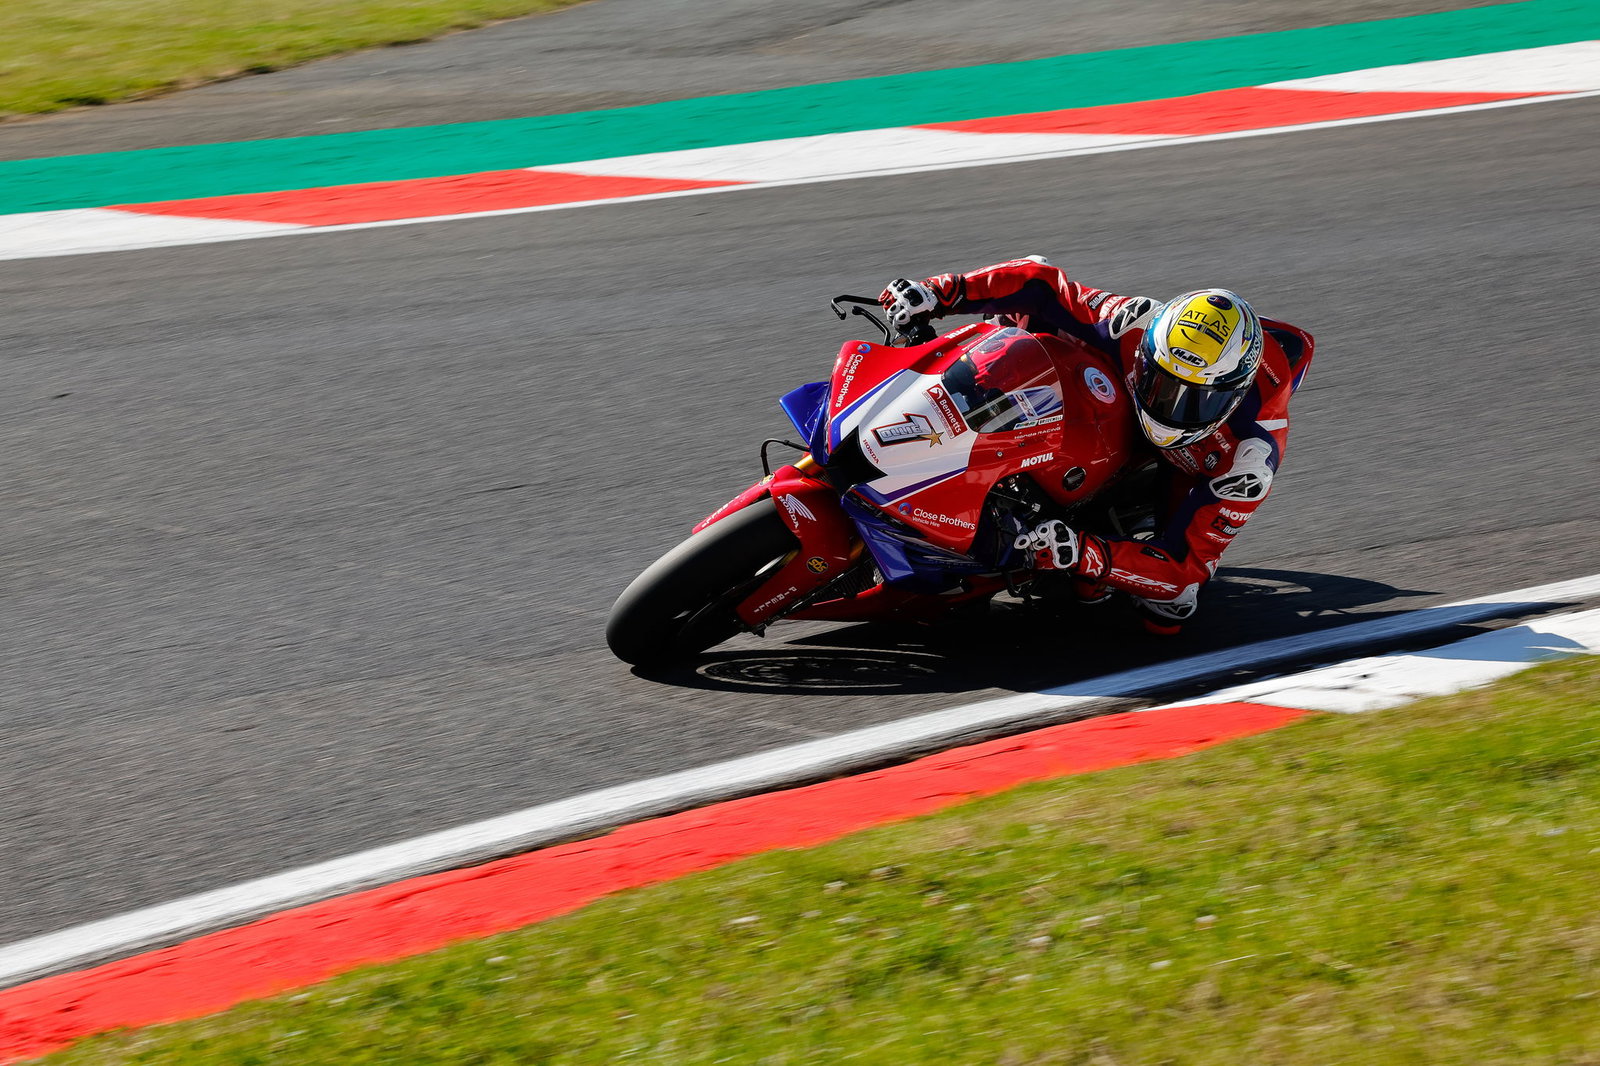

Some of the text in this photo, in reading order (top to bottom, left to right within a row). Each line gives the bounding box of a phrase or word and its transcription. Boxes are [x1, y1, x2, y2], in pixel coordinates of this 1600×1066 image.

[1182, 310, 1231, 337] ATLAS
[1173, 349, 1203, 366] HJC
[836, 354, 864, 408] Close Brothers
[939, 397, 962, 433] Bennetts
[862, 439, 880, 464] HONDA
[1020, 452, 1054, 469] MOTUL
[777, 495, 800, 529] HONDA
[913, 508, 976, 530] Close Brothers
[1218, 507, 1253, 521] MOTU
[753, 586, 798, 613] PIRELLI
